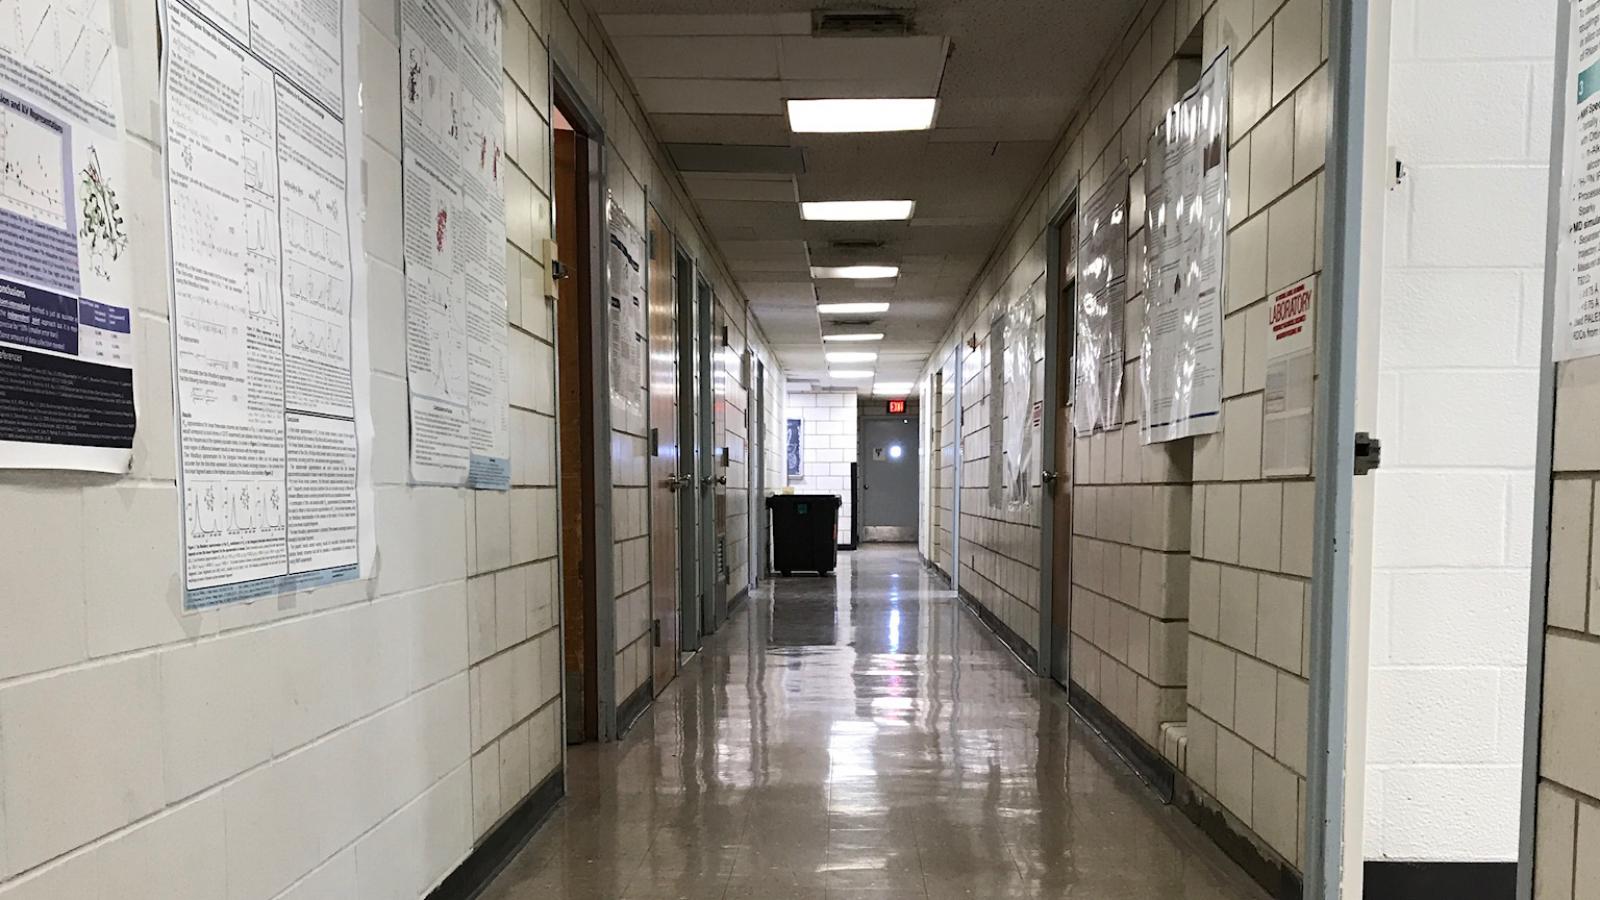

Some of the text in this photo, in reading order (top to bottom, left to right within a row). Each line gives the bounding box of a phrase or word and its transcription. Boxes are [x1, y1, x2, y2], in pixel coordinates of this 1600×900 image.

[1579, 81, 1584, 95] 3
[1269, 289, 1312, 325] LABORATORY
[889, 401, 904, 413] EXIT
